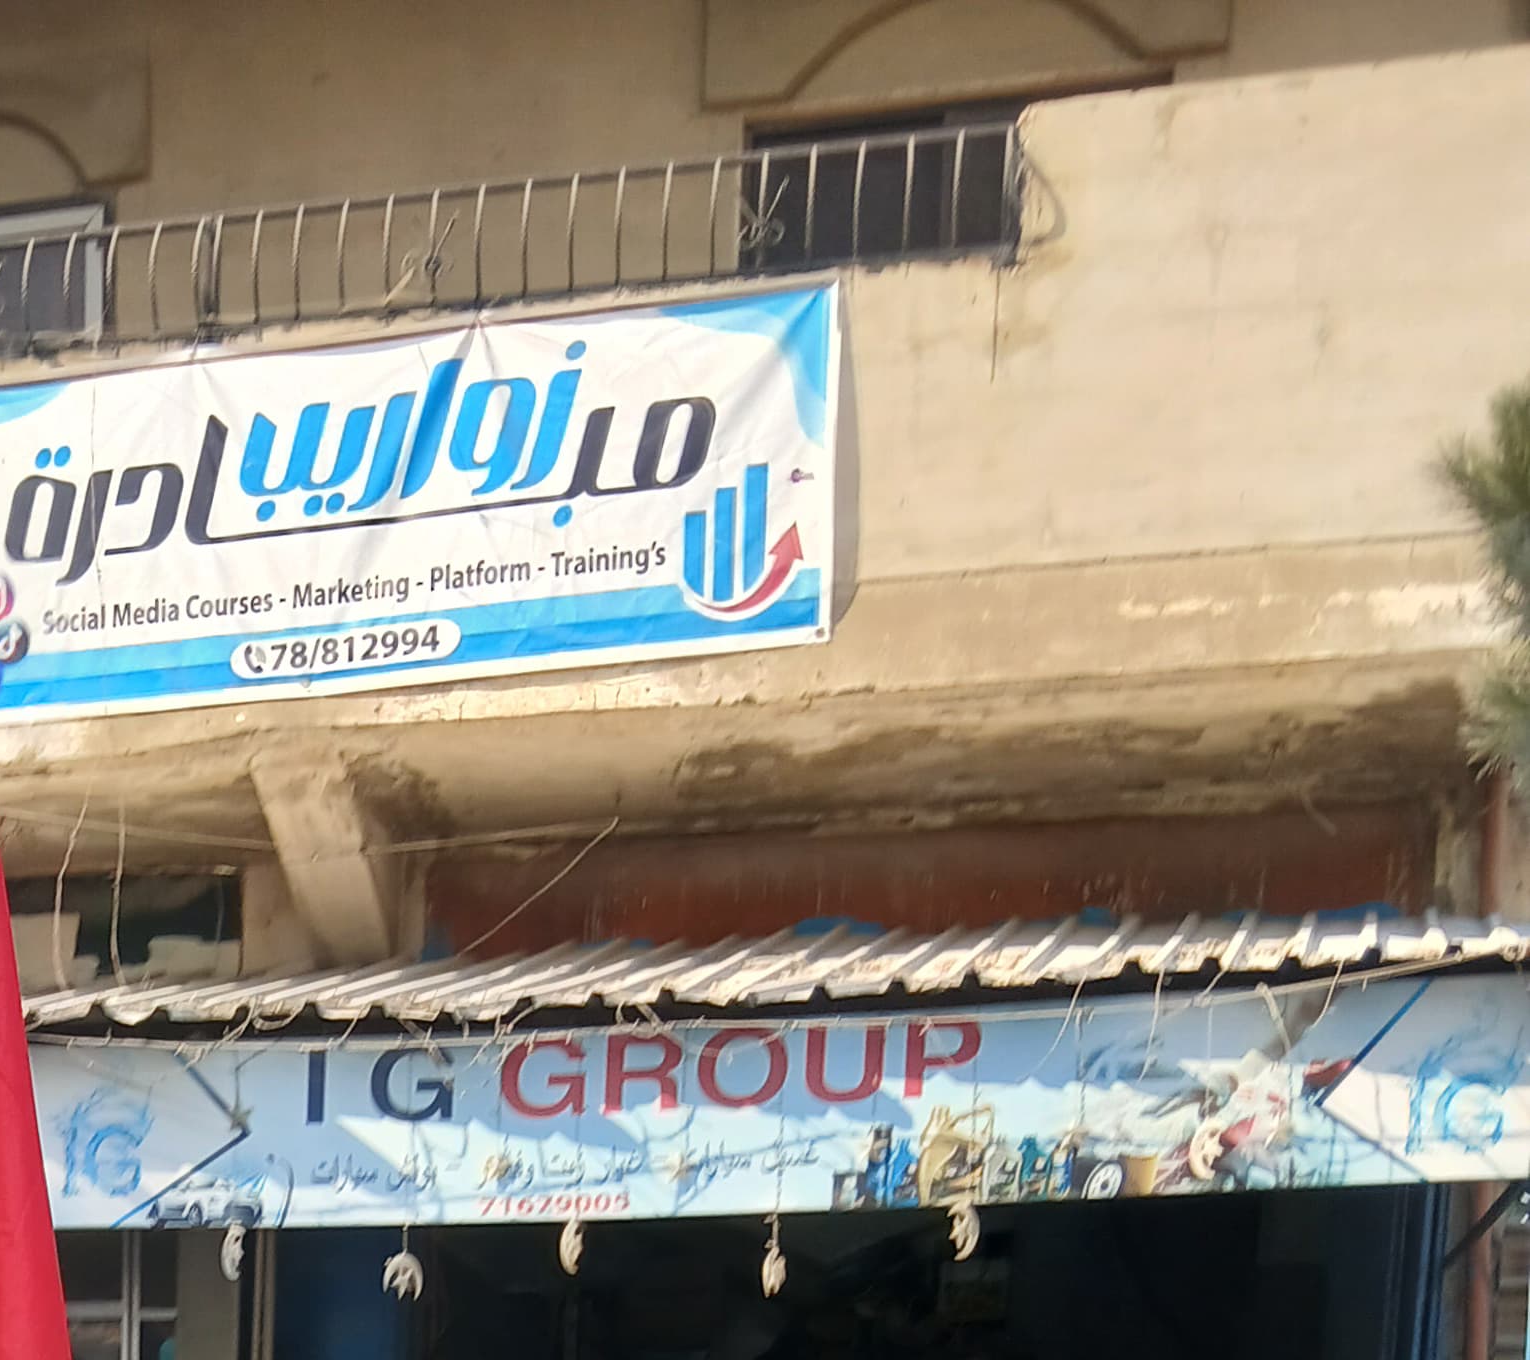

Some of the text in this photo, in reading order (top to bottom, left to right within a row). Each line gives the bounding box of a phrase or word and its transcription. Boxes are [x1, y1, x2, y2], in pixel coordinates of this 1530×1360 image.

[43, 604, 106, 635] Social
[112, 598, 180, 629] Media
[186, 592, 273, 620] Courses
[293, 575, 410, 609] Marketing
[430, 559, 531, 592] Platform
[551, 541, 667, 577] Training's
[271, 625, 440, 671] 78/812994
[500, 1022, 981, 1118] GROUP
